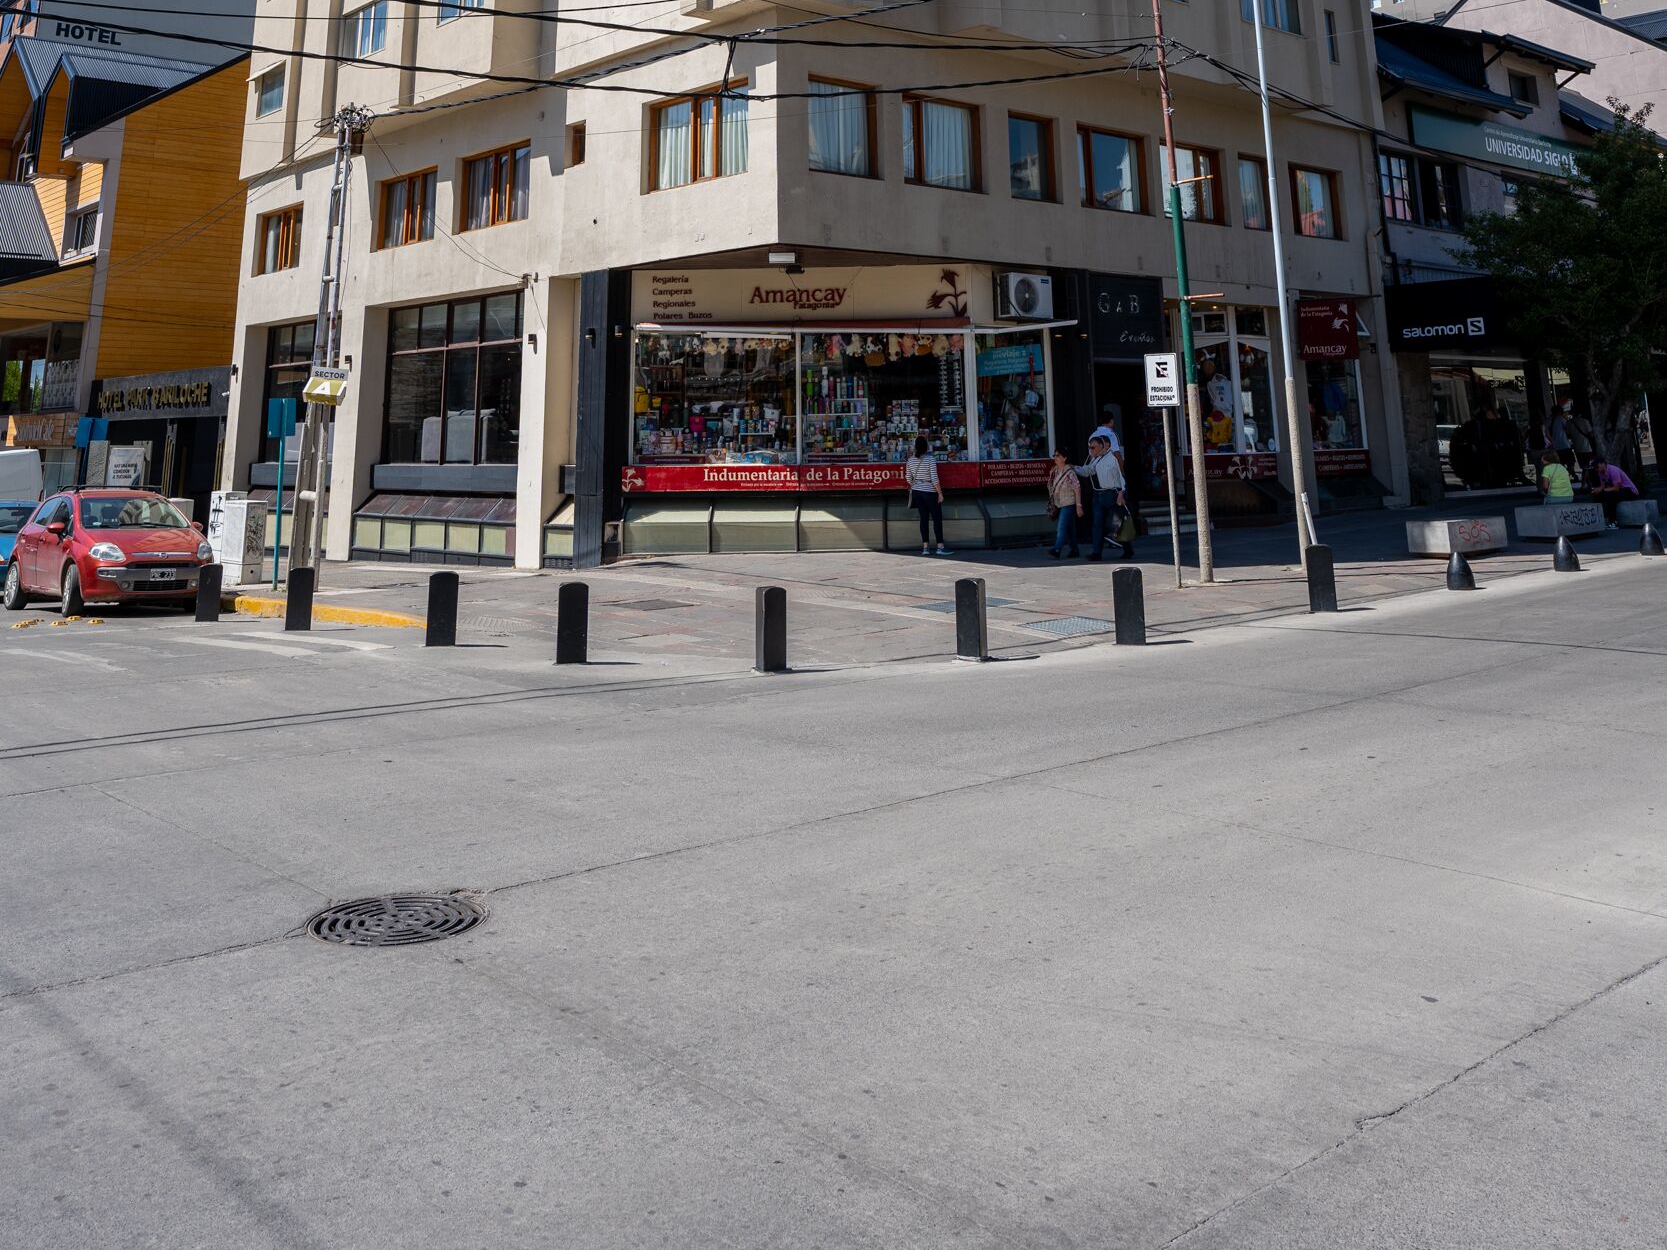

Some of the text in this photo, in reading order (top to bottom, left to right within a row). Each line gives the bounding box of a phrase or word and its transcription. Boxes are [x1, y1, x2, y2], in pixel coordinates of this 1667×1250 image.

[56, 22, 122, 46] HOTEL
[1485, 136, 1543, 163] UNIVERSIDAD
[652, 275, 689, 286] Regalería
[652, 288, 693, 298] Camperas
[749, 286, 848, 307] Amancay
[653, 299, 696, 310] Regionales
[793, 301, 839, 311] Patagonia
[653, 312, 683, 320] Polares
[1402, 324, 1465, 338] salomon
[1303, 344, 1347, 355] Amancay
[315, 370, 345, 379] SECTOR
[312, 381, 332, 397] A
[98, 381, 209, 410] HOTEL PARK BARILOCHE
[703, 466, 905, 484] Indumentaria de la Patagoni
